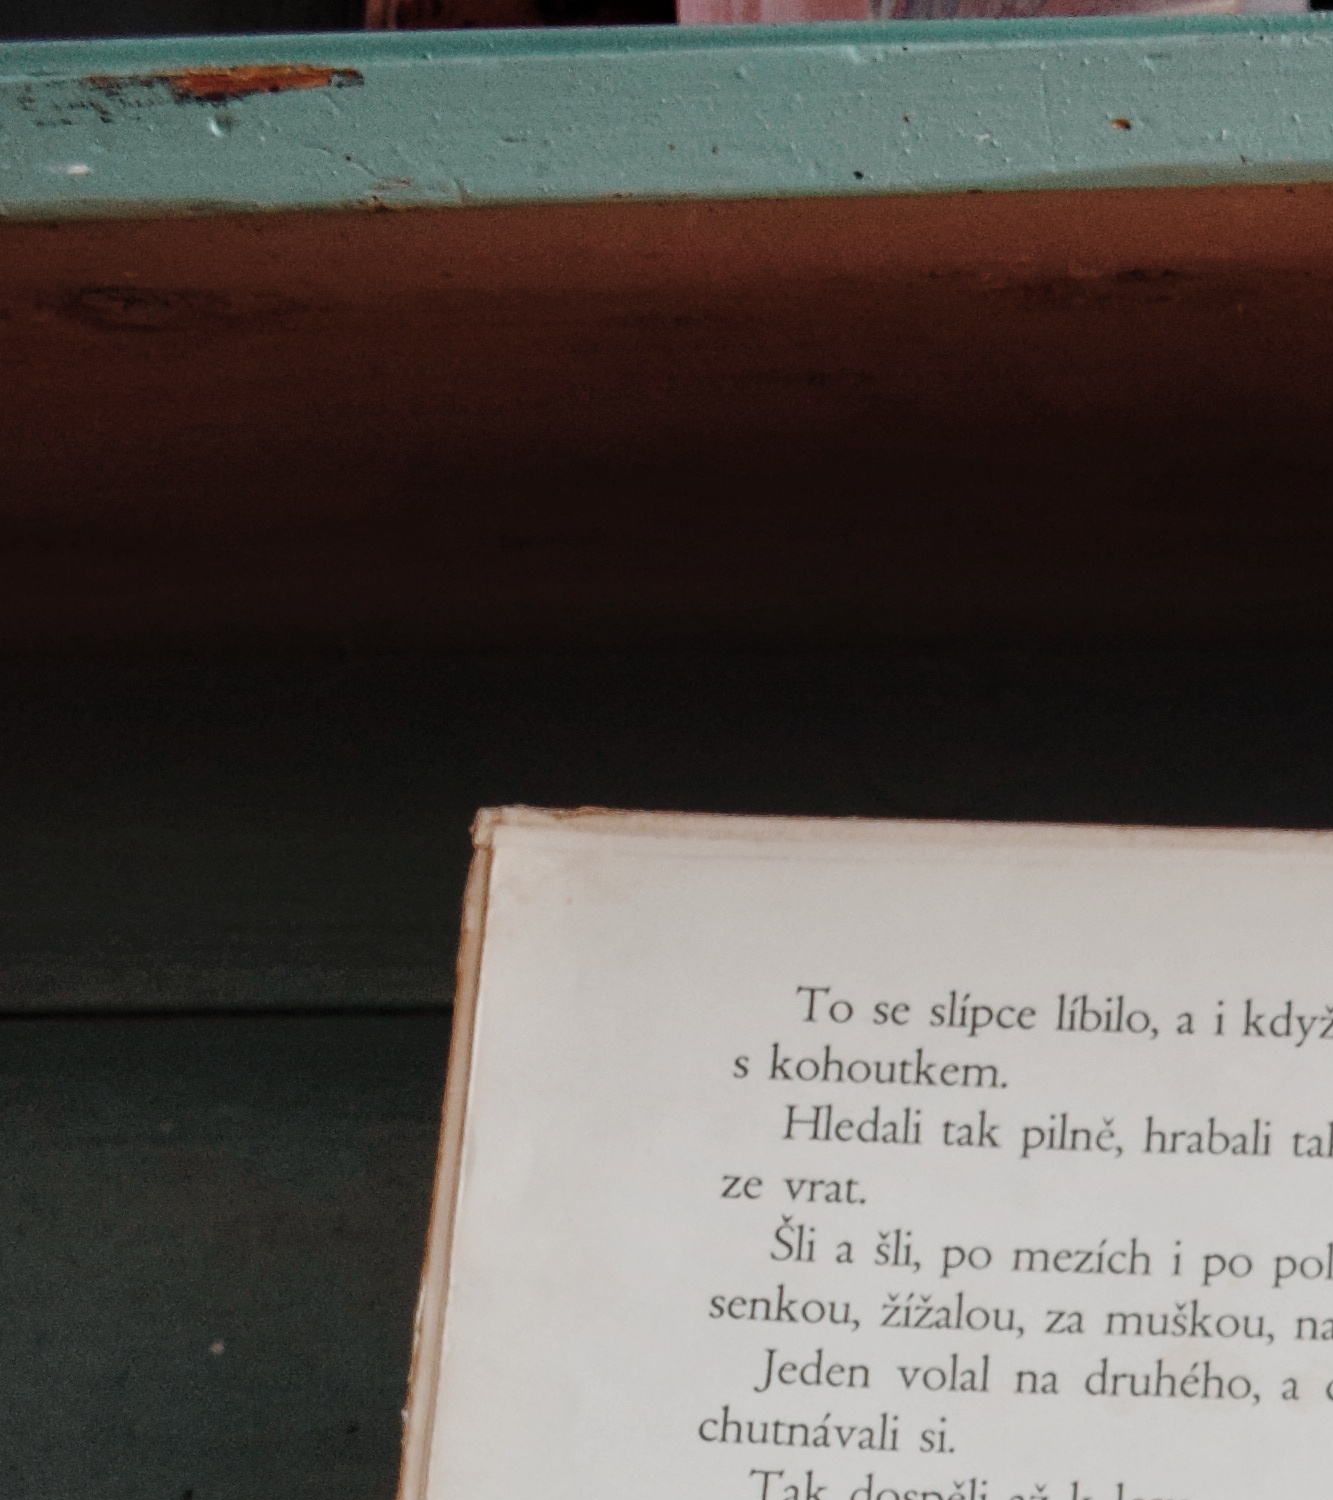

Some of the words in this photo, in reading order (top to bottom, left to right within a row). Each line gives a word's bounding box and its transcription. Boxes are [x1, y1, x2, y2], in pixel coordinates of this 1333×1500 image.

[795, 984, 855, 1024] To
[872, 1001, 911, 1027] se
[929, 989, 1037, 1039] slípce
[1055, 992, 1160, 1040] líbilo,
[1175, 1010, 1197, 1037] a
[1213, 998, 1226, 1038] i
[731, 1054, 751, 1080] s
[768, 1041, 1008, 1090] kohoutkem.
[782, 1103, 922, 1146] Hledali
[942, 1108, 1001, 1149] tak
[1020, 1111, 1124, 1160] pilně,
[1143, 1115, 1272, 1157] hrabali
[720, 1174, 764, 1200] ze
[783, 1177, 866, 1206] vrat.
[769, 1213, 816, 1263] Šli
[834, 1239, 856, 1266] a
[874, 1227, 922, 1274] šli,
[939, 1245, 993, 1279] po
[1012, 1236, 1151, 1276] mezích
[1170, 1238, 1183, 1278] i
[1201, 1253, 1254, 1288] po
[708, 1283, 861, 1333] senkou,
[880, 1290, 1025, 1339] žížalou,
[1044, 1309, 1085, 1335] za
[1104, 1298, 1275, 1346] muškou,
[753, 1347, 870, 1394] Jeden
[896, 1352, 990, 1393] volal
[1015, 1369, 1059, 1395] na
[1084, 1356, 1261, 1406] druhého,
[1280, 1375, 1302, 1402] a
[697, 1403, 899, 1452] chutnávali
[919, 1416, 956, 1454] si.
